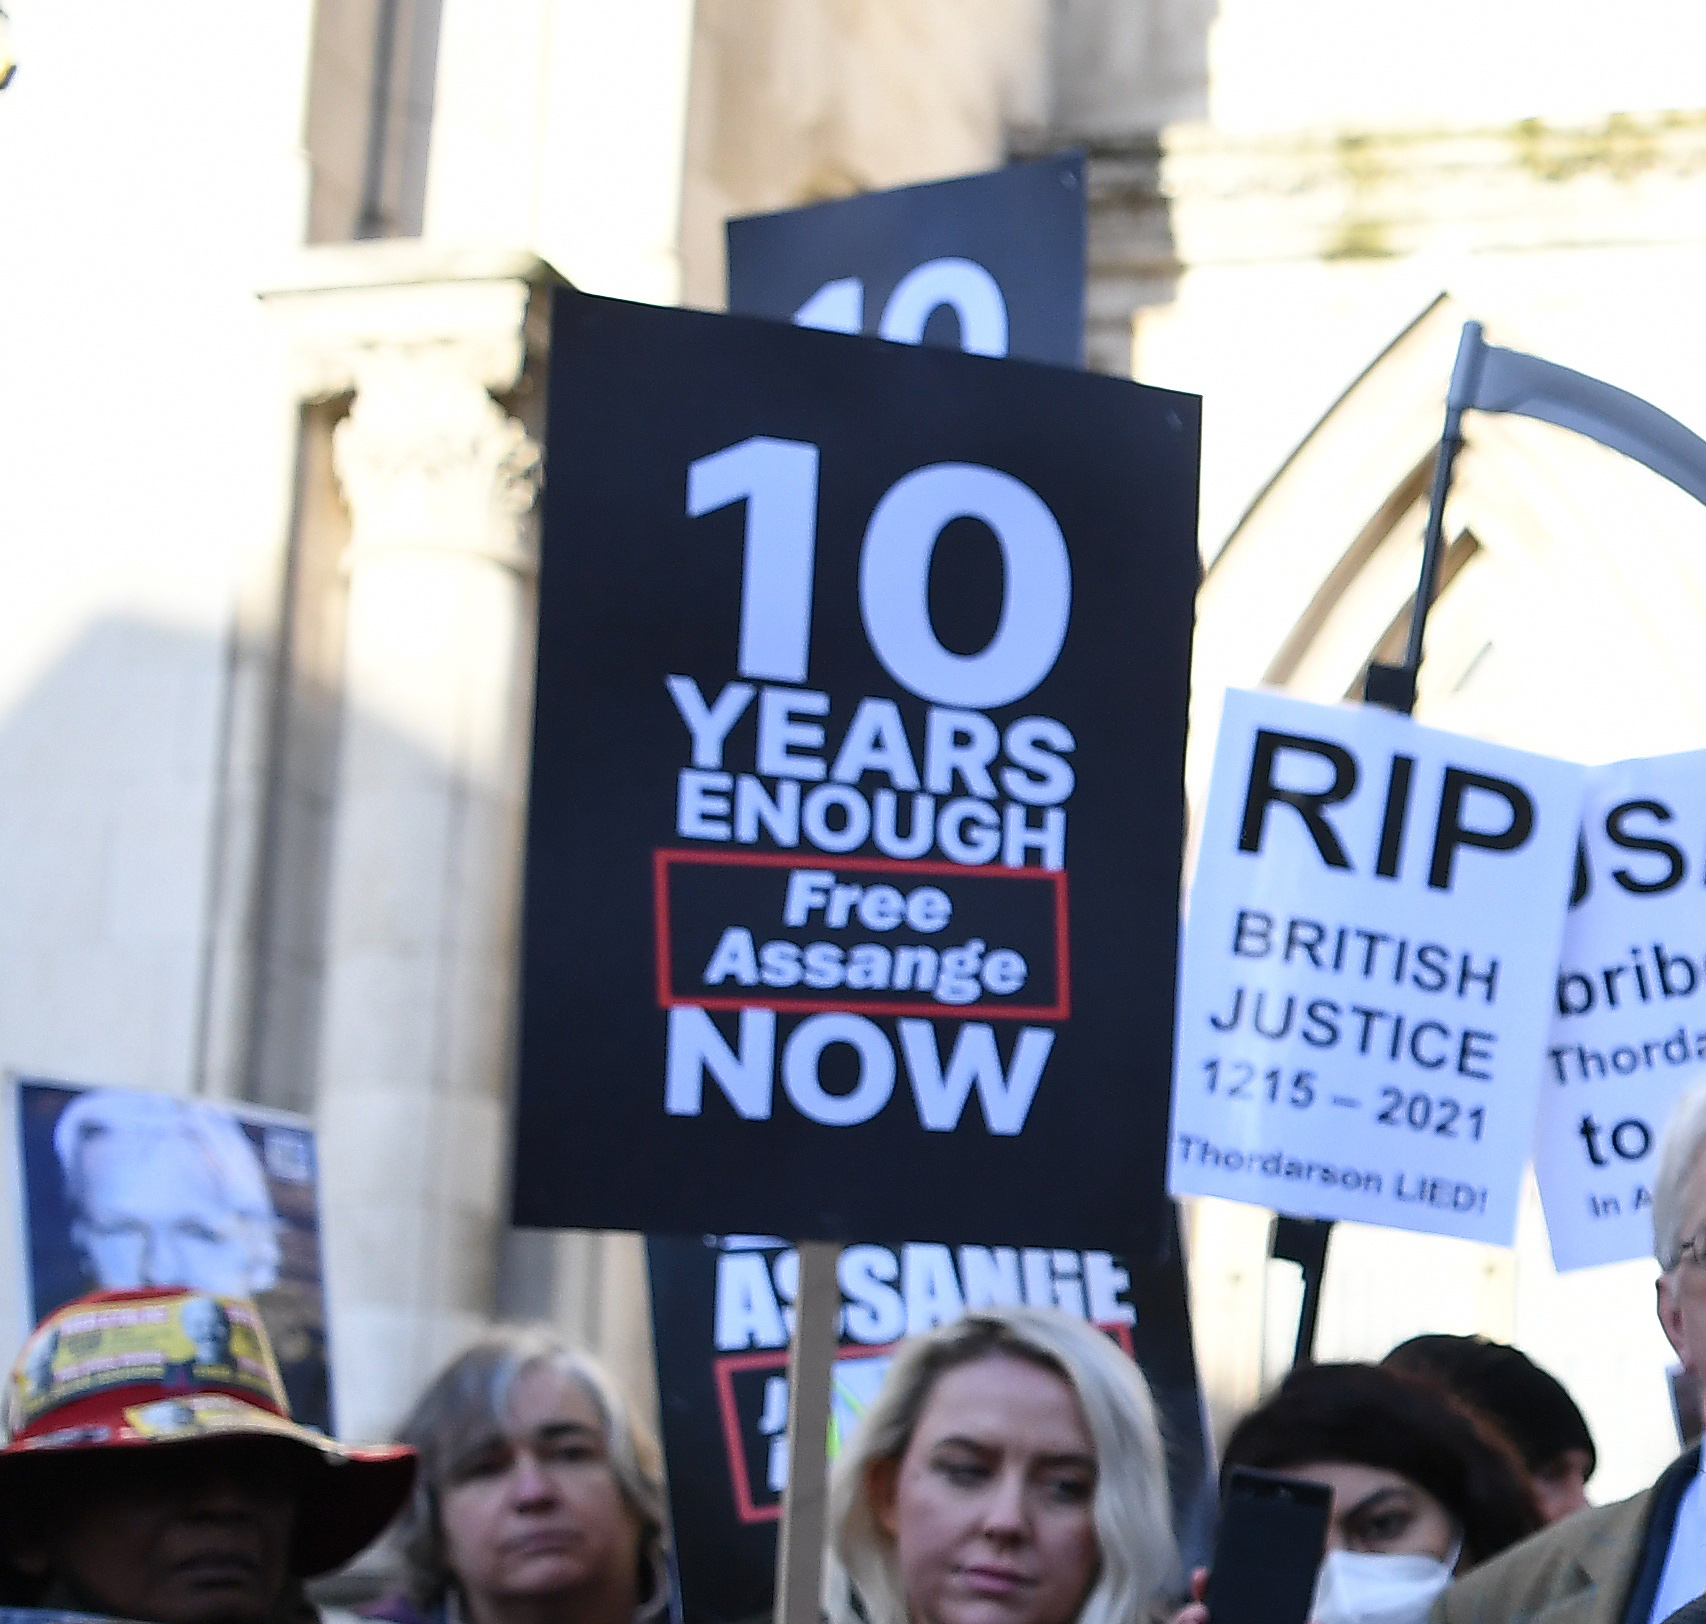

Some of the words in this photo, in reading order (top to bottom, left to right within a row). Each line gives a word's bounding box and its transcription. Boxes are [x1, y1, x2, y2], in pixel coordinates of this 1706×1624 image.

[684, 434, 1074, 712] 10
[664, 672, 1077, 806] YEARS
[676, 766, 1068, 872] ENOUGH
[1237, 728, 1538, 891] RIP
[783, 869, 953, 934] Free
[704, 926, 1029, 1004] Assange
[1232, 908, 1499, 1004] BRITISH
[663, 1005, 1057, 1137] NOW
[1209, 986, 1498, 1082] JUSTICE
[1201, 1056, 1319, 1110] 1215
[1375, 1086, 1488, 1143] 2021
[1580, 1114, 1652, 1167] to
[1178, 1133, 1383, 1195] Thordarson
[1397, 1171, 1490, 1216] LIED!
